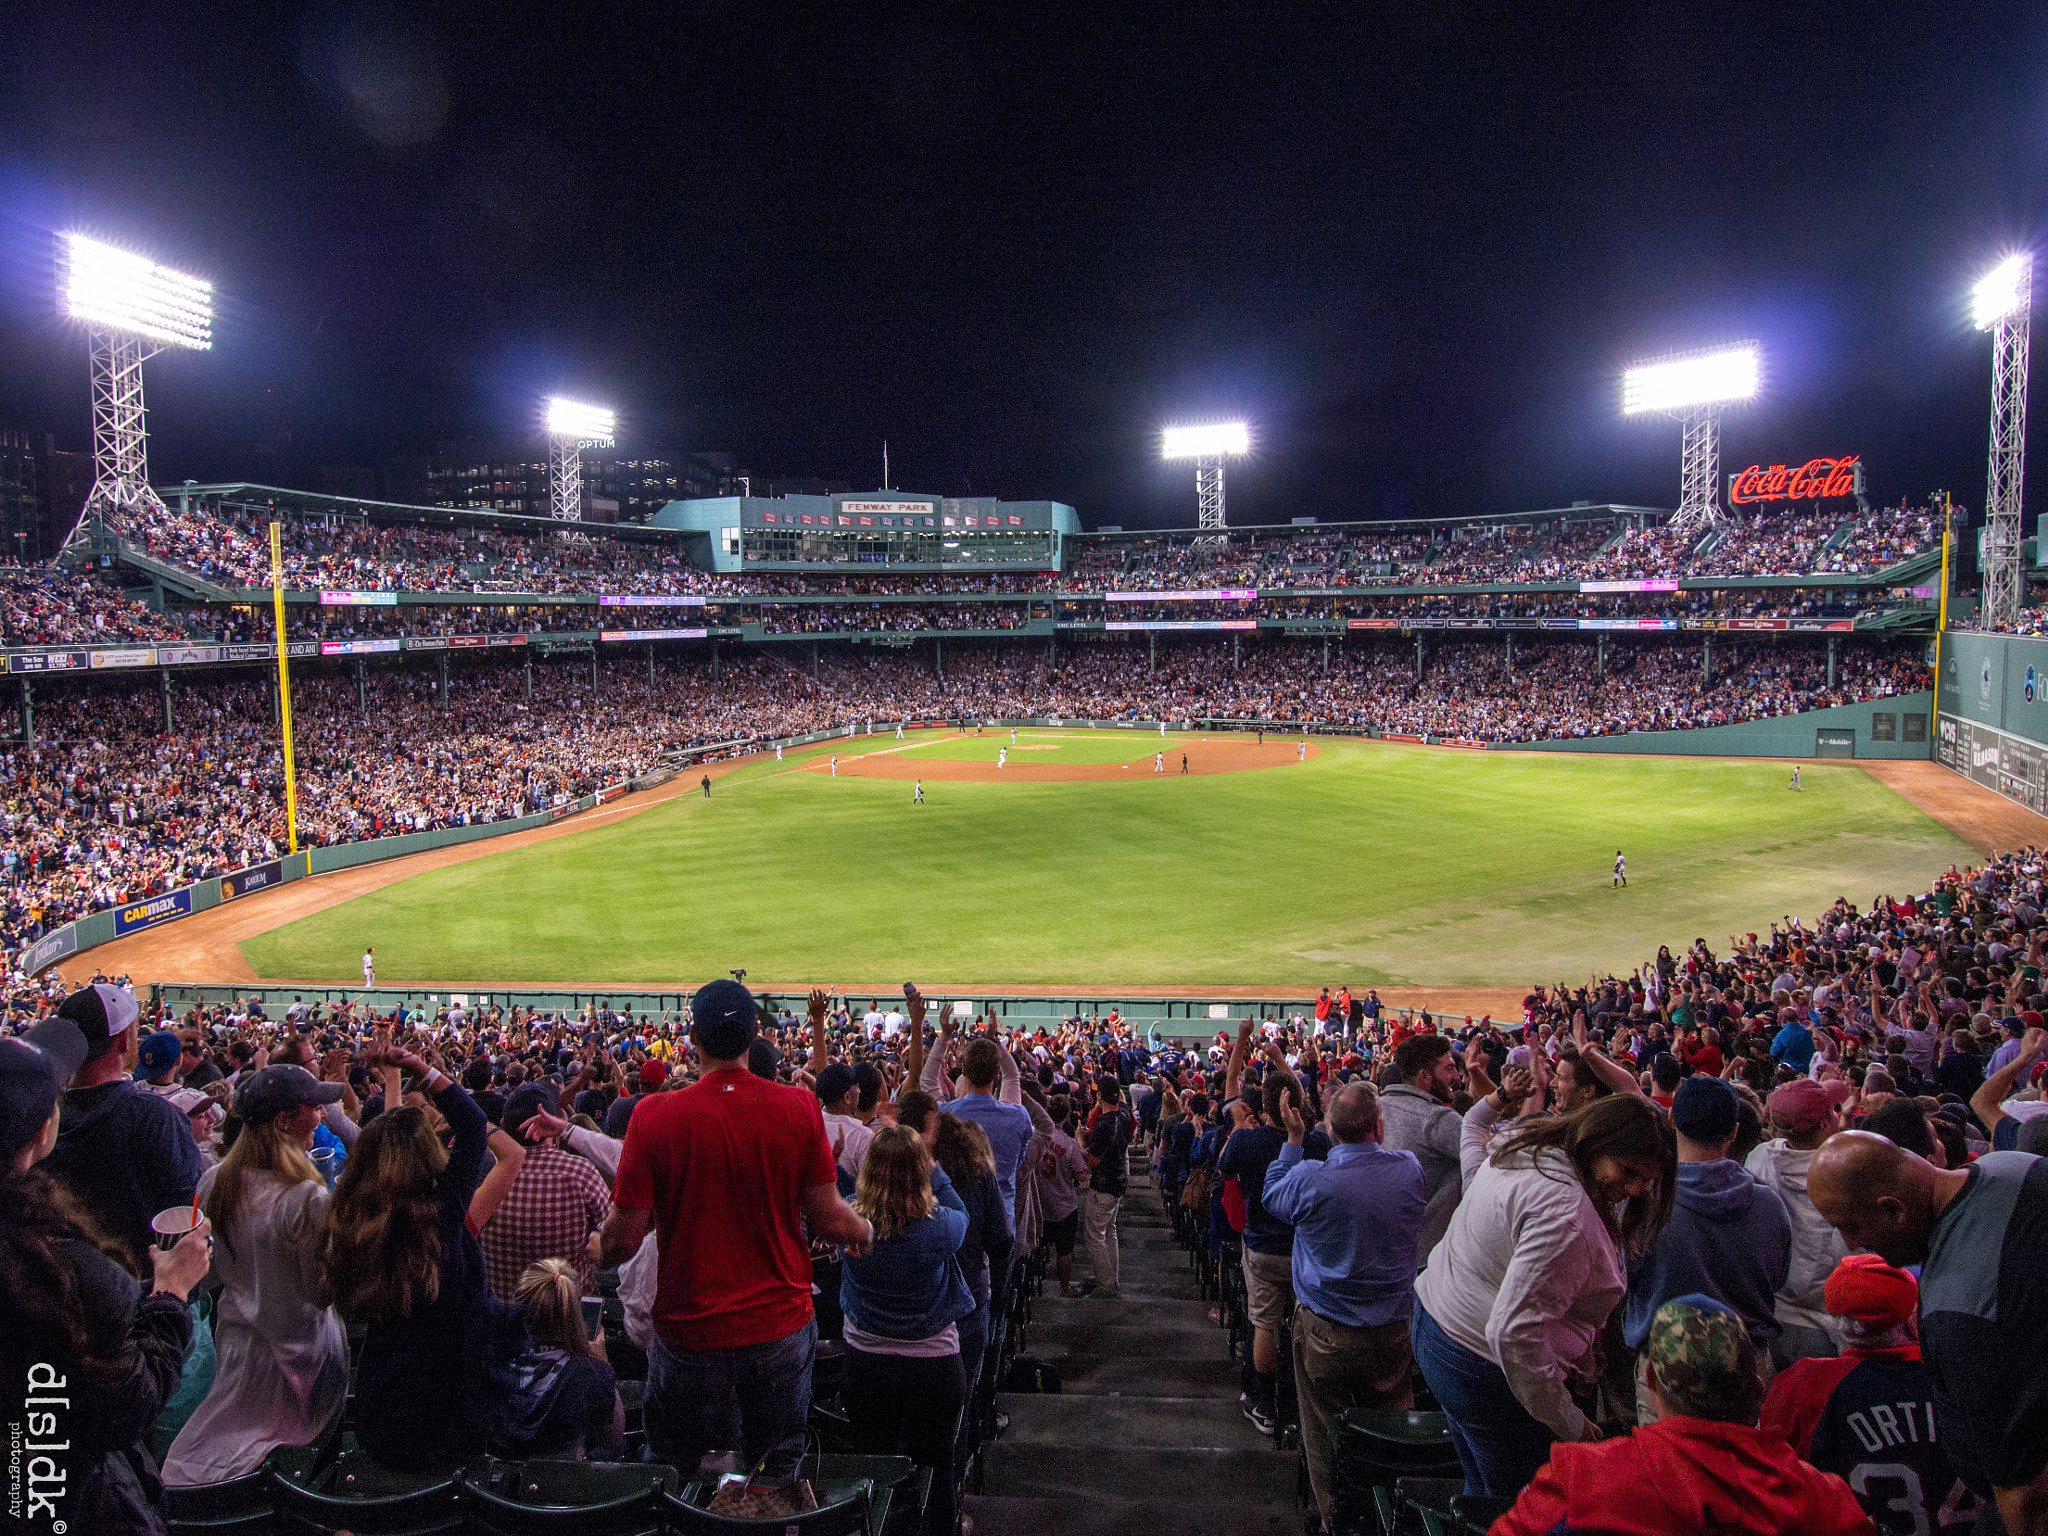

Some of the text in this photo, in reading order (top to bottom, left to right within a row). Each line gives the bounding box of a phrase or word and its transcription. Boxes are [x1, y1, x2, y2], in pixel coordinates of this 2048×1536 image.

[578, 439, 615, 449] OPTUM
[1731, 455, 1861, 504] Coca-Cola
[847, 503, 928, 512] FENWAY PARK
[1685, 620, 1701, 629] Tribe
[291, 644, 304, 655] AND
[305, 644, 316, 654] ANI
[1944, 721, 1956, 743] CVS
[245, 872, 267, 890] KAYEM
[124, 896, 176, 923] CARmax
[1846, 1401, 1937, 1453] ORTI
